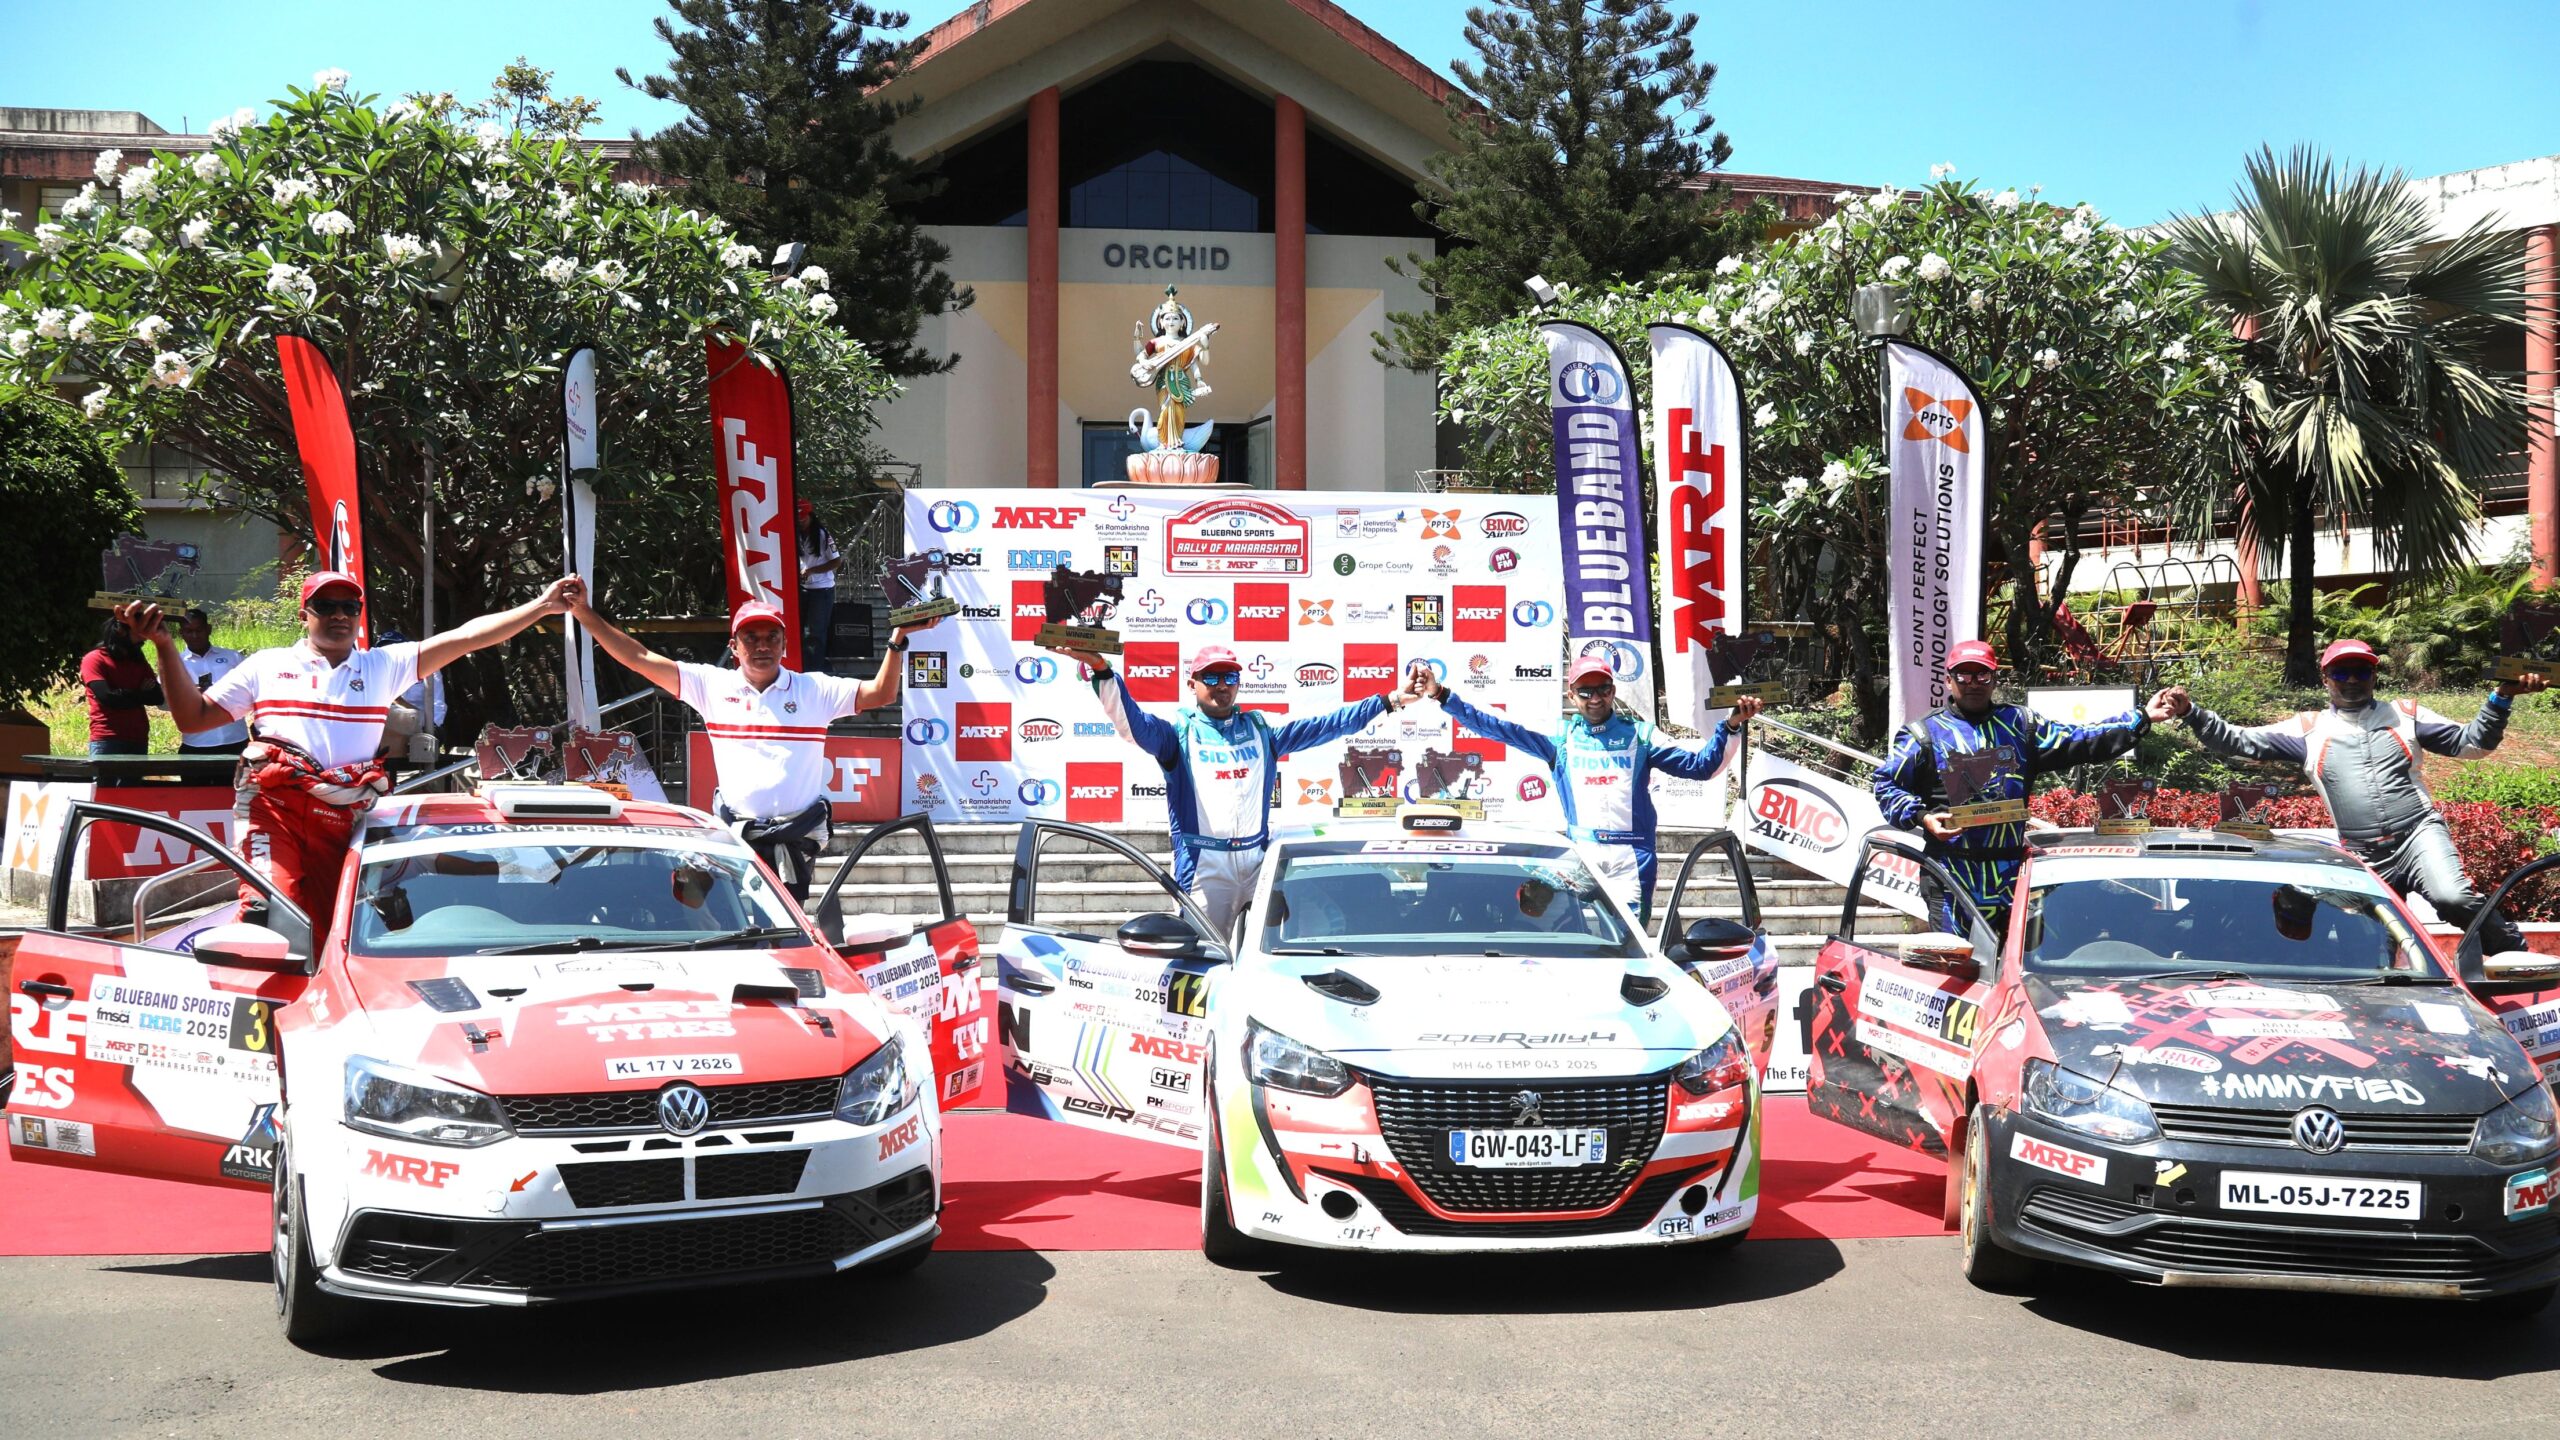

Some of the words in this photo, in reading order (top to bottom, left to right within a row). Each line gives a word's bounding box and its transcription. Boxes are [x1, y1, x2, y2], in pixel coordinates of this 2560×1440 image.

[1103, 243, 1230, 271] ORCHID
[1561, 362, 1597, 379] BLUEBAND
[1920, 411, 1954, 430] PPTS
[992, 506, 1086, 529] MRF
[1363, 520, 1397, 528] Delivering
[1431, 520, 1451, 529] PPTS
[1485, 518, 1525, 532] BMC
[1568, 412, 1635, 634] BLUEBAND
[1935, 463, 1954, 583] SOLUTIONS
[1201, 529, 1242, 537] BLUEBAND
[1244, 529, 1275, 537] SPORTS
[1363, 526, 1397, 534] Happiness
[1486, 530, 1504, 539] Air
[1668, 407, 1725, 653] MRF
[1177, 543, 1207, 552] RALLY
[1209, 543, 1221, 553] OF
[1225, 543, 1298, 553] MAHARASHTRA
[1912, 507, 1928, 600] PERFECT
[1008, 549, 1072, 568] INRC
[1227, 561, 1258, 569] MRF
[1359, 562, 1384, 571] Grape
[1385, 561, 1414, 571] County
[1496, 554, 1510, 562] MY
[1497, 559, 1513, 568] FM
[962, 604, 1001, 618] fmsci
[1238, 606, 1285, 618] MRF
[1307, 608, 1325, 617] PPTS
[1456, 608, 1503, 620] MRF
[1066, 630, 1096, 640] WINNER
[1912, 607, 1925, 668] POINT
[1930, 585, 1950, 709] ECHNOLOGY
[1128, 666, 1175, 678] MRF
[1300, 668, 1334, 680] BMC
[1347, 666, 1395, 679] MRF
[1515, 665, 1552, 677] fmsci
[960, 726, 1008, 738] MRF
[1023, 724, 1059, 736] BMC
[1573, 755, 1632, 769] SIDVIN
[1215, 768, 1249, 780] MRF
[1584, 776, 1618, 786] MRF
[1070, 786, 1118, 798] MRF
[1131, 783, 1167, 797] fmsc
[1306, 788, 1324, 796] PPTS
[1524, 781, 1538, 790] MY
[1525, 785, 1543, 797] FM
[1666, 788, 1703, 797] Happiness
[1757, 786, 1841, 844] BMC
[1972, 806, 2001, 816] WINNER
[445, 824, 514, 833] ARKA
[1750, 819, 1790, 845] Air
[1791, 831, 1823, 853] Filter
[2049, 848, 2135, 856] AMMYFIED
[1865, 868, 1904, 890] Air
[877, 962, 912, 986] BLUEBAND
[912, 954, 937, 973] SPORTS
[1708, 962, 1735, 981] BLUEBAND
[919, 972, 940, 990] 2025
[1740, 971, 1753, 987] 2025
[1069, 976, 1093, 989] fmsci
[1135, 988, 1166, 1005] 2025
[1172, 973, 1206, 1018] 12
[1876, 978, 1914, 1001] BLUEBAND
[1914, 991, 1945, 1012] SPORTS
[114, 987, 178, 1010] BLUEBAND
[182, 997, 231, 1017] SPORTS
[1073, 1002, 1097, 1012] MRF
[556, 1001, 732, 1025] MRF
[1915, 1011, 1941, 1030] 2025
[2519, 1009, 2558, 1031] BLUEBAND
[96, 1007, 130, 1024] fmsci
[186, 1020, 228, 1039] 2025
[245, 1002, 270, 1051] 3
[1946, 998, 1979, 1046] 14
[587, 1020, 737, 1042] TYRES
[105, 1040, 135, 1052] MRF
[1129, 1032, 1208, 1065] MRF
[93, 1051, 124, 1062] RALLY
[129, 1056, 140, 1065] OF
[146, 1059, 219, 1076] MAHARASHTRA
[616, 1062, 640, 1074] KL
[647, 1060, 665, 1071] 17
[673, 1059, 684, 1070] V
[692, 1058, 733, 1070] 2626
[1452, 1061, 1473, 1070] MH
[1477, 1060, 1493, 1070] 46
[1496, 1060, 1531, 1070] TEMP
[1535, 1060, 1560, 1069] 043
[1567, 1060, 1598, 1070] 2025
[2160, 1050, 2215, 1069] BMC
[1151, 1067, 1191, 1091] GT2i
[1766, 1067, 1787, 1080] The
[879, 1114, 919, 1161] MRF
[1455, 1150, 1461, 1159] F
[1471, 1134, 1586, 1159] GW-043-LF
[1591, 1147, 1604, 1160] 52
[224, 1144, 272, 1169] ARK
[2018, 1138, 2094, 1176] MRF
[360, 1149, 460, 1188] MRF
[2229, 1184, 2410, 1209] ML-05J-7225
[1660, 1218, 1694, 1235] GT2i
